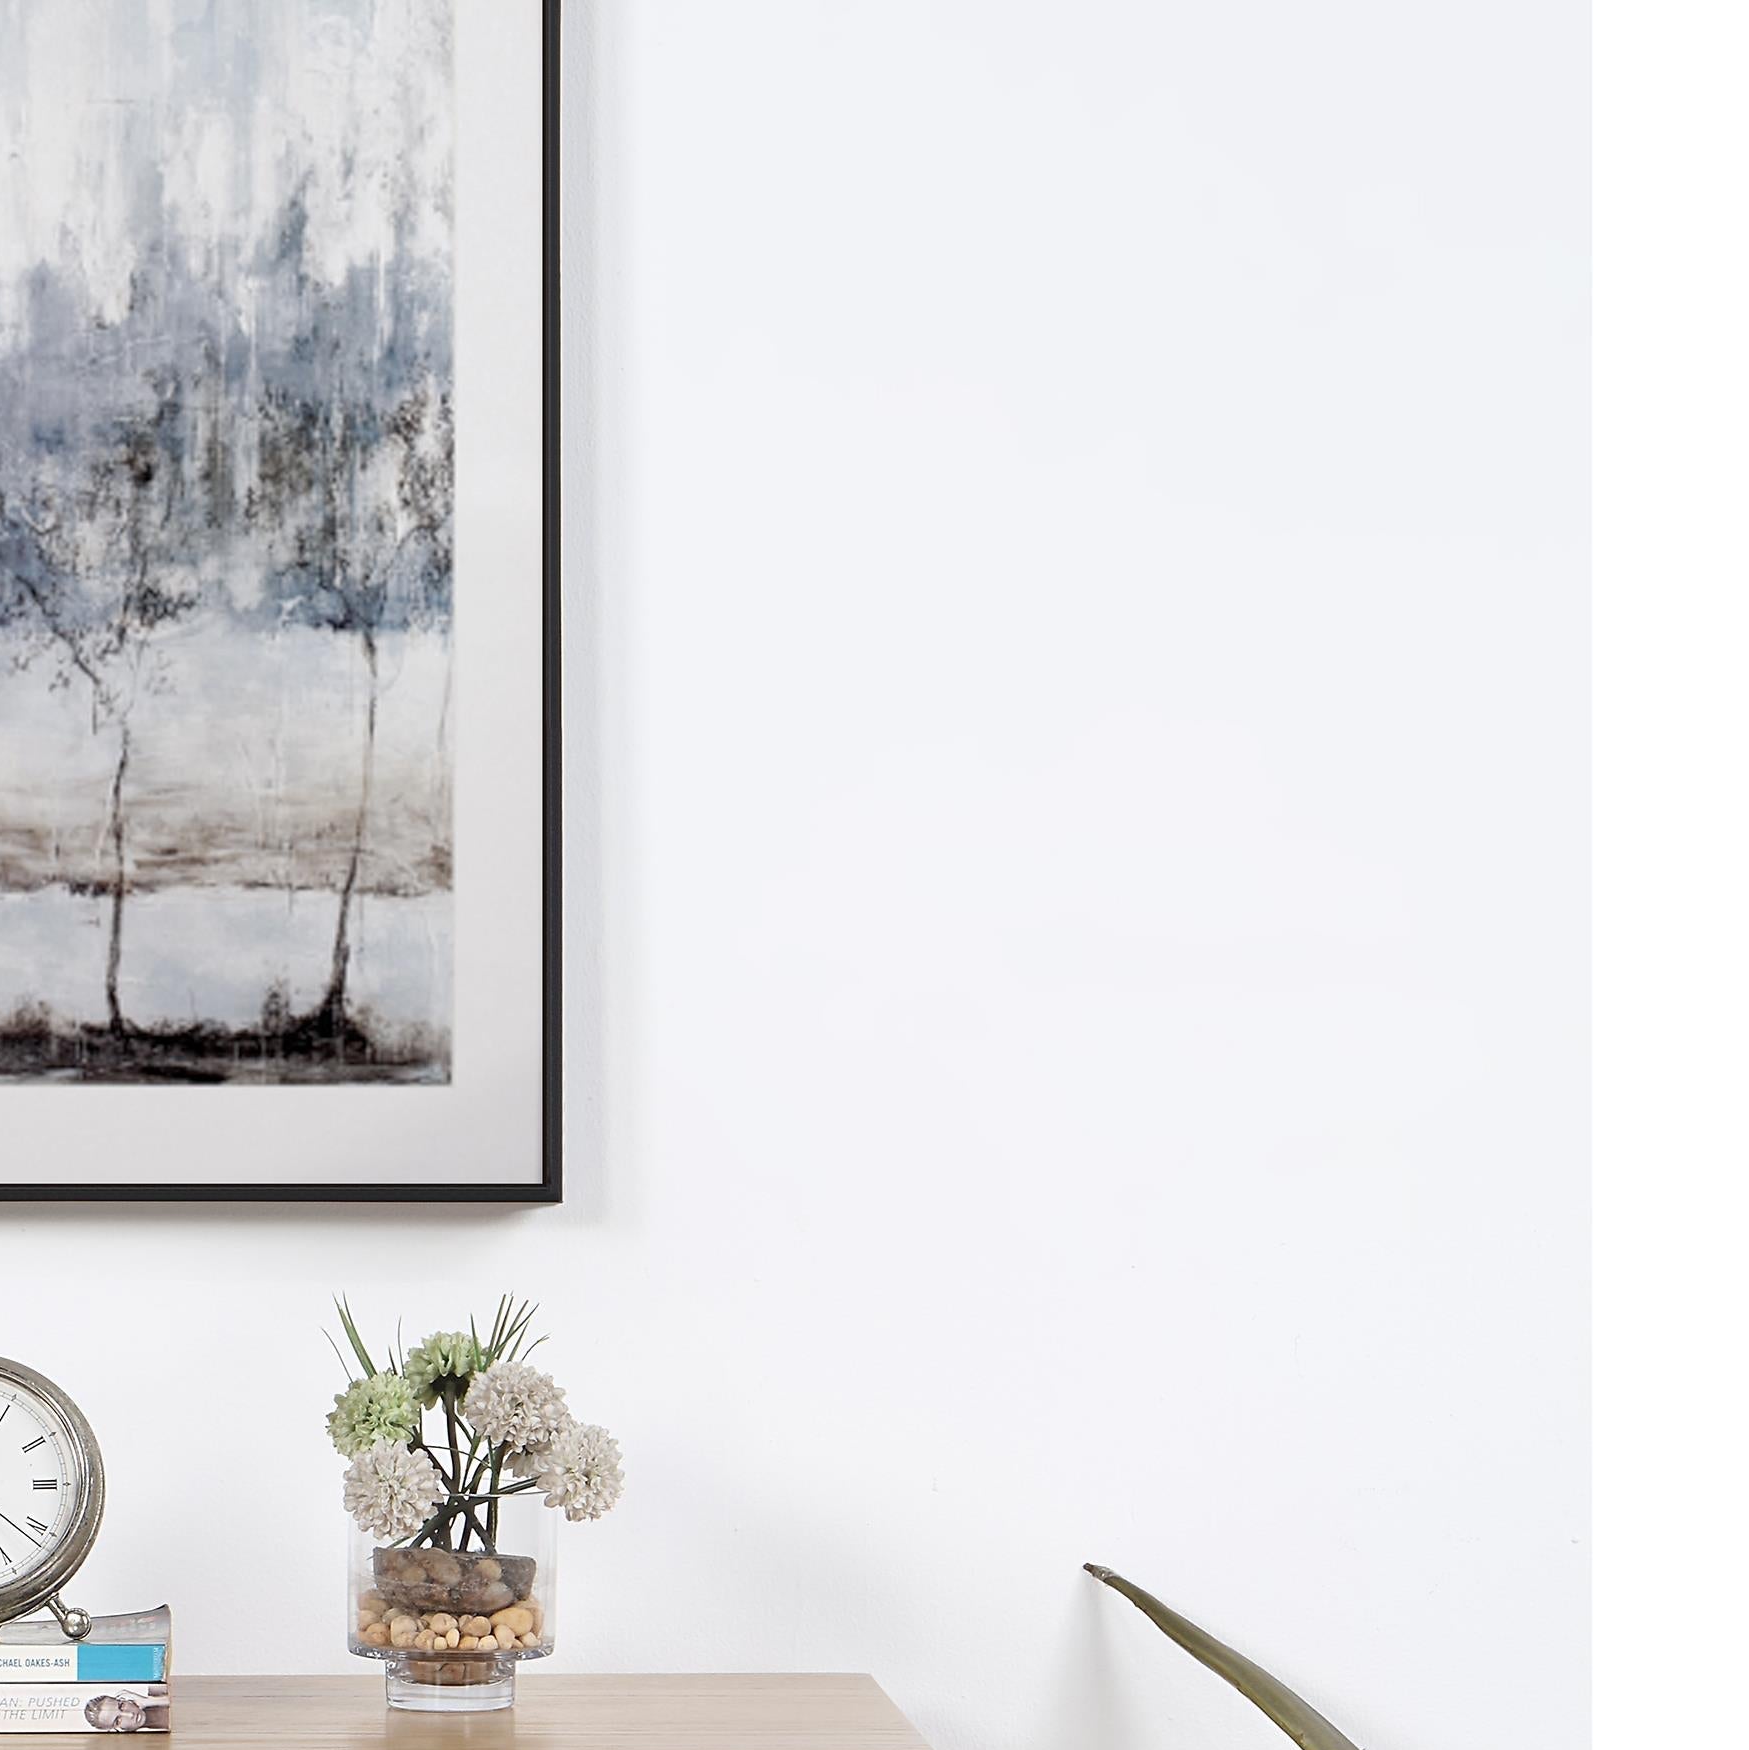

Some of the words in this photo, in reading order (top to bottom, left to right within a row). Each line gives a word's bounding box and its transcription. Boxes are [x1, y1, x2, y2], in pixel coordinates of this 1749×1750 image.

[22, 1436, 46, 1454] II
[32, 1479, 57, 1490] III
[25, 1658, 70, 1668] OAKES-ASH
[27, 1697, 80, 1707] PUSHED
[4, 1709, 27, 1720] THE
[31, 1709, 67, 1720] LIMIT
